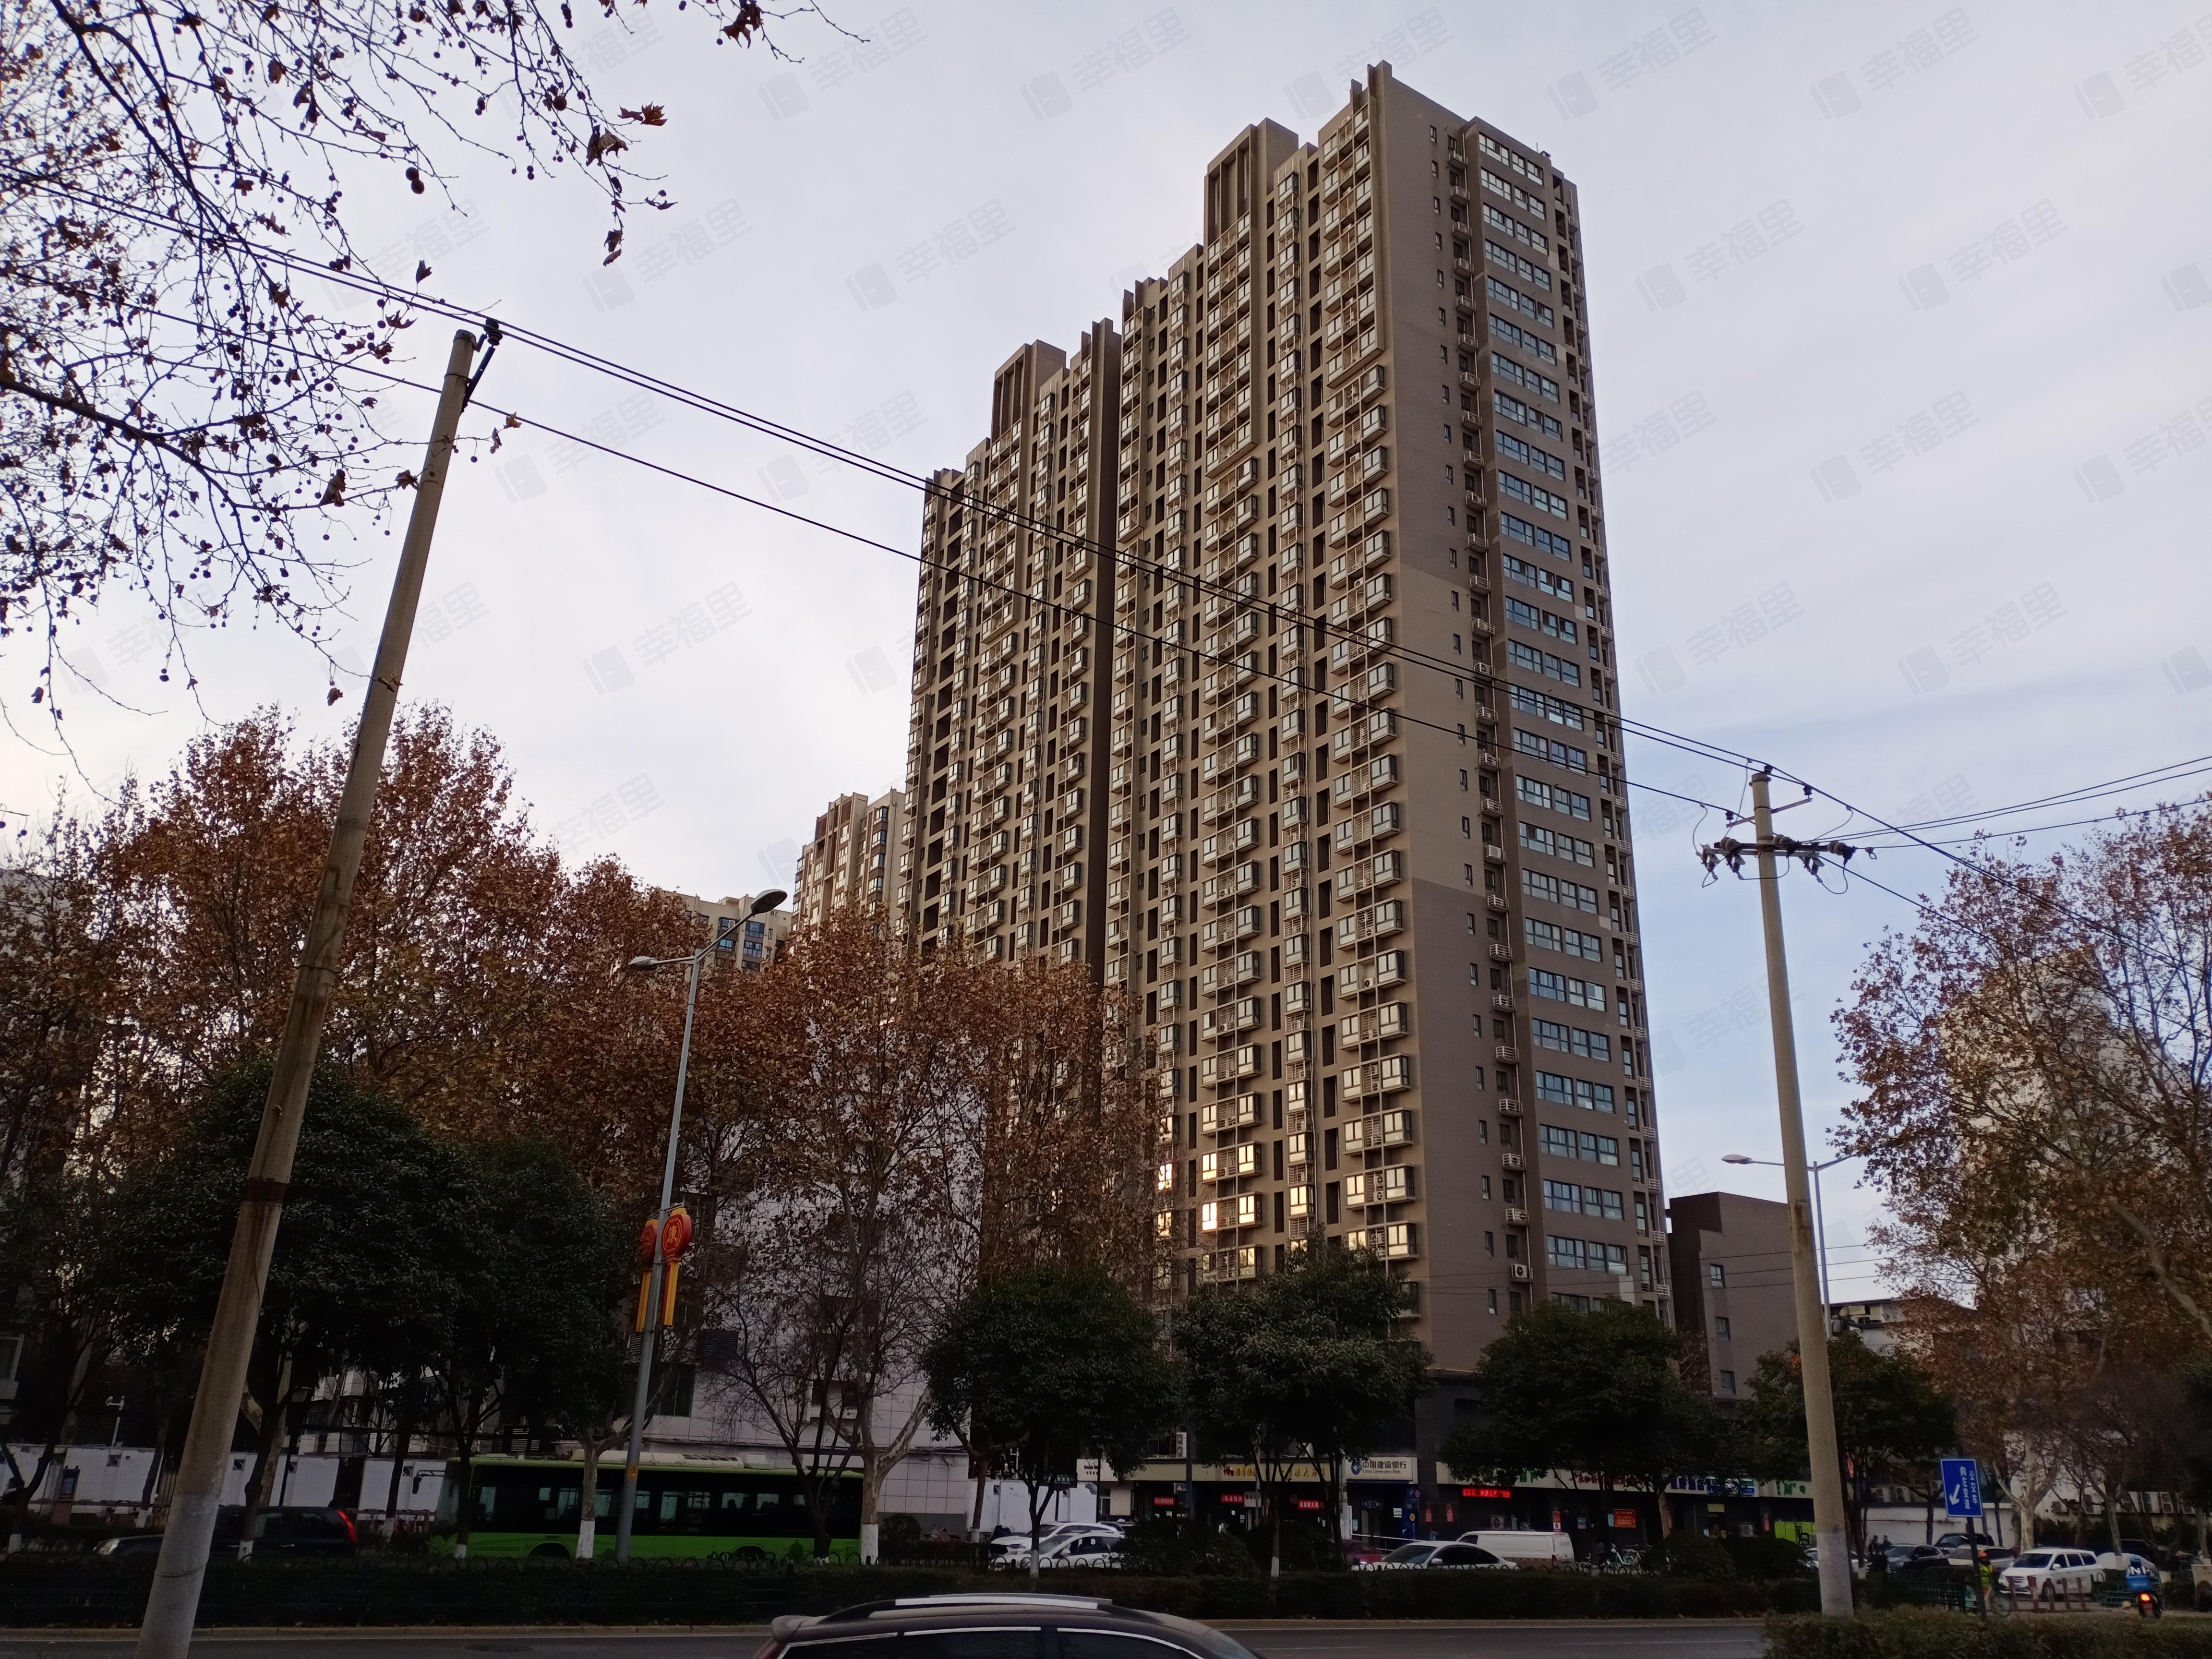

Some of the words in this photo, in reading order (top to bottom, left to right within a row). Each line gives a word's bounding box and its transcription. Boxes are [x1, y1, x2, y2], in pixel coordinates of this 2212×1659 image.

[667, 1226, 677, 1244] 康
[1363, 1460, 1407, 1469] 中国建设银行
[1960, 1466, 1971, 1510] 向左变道
[1969, 1470, 1979, 1505] 公交车
